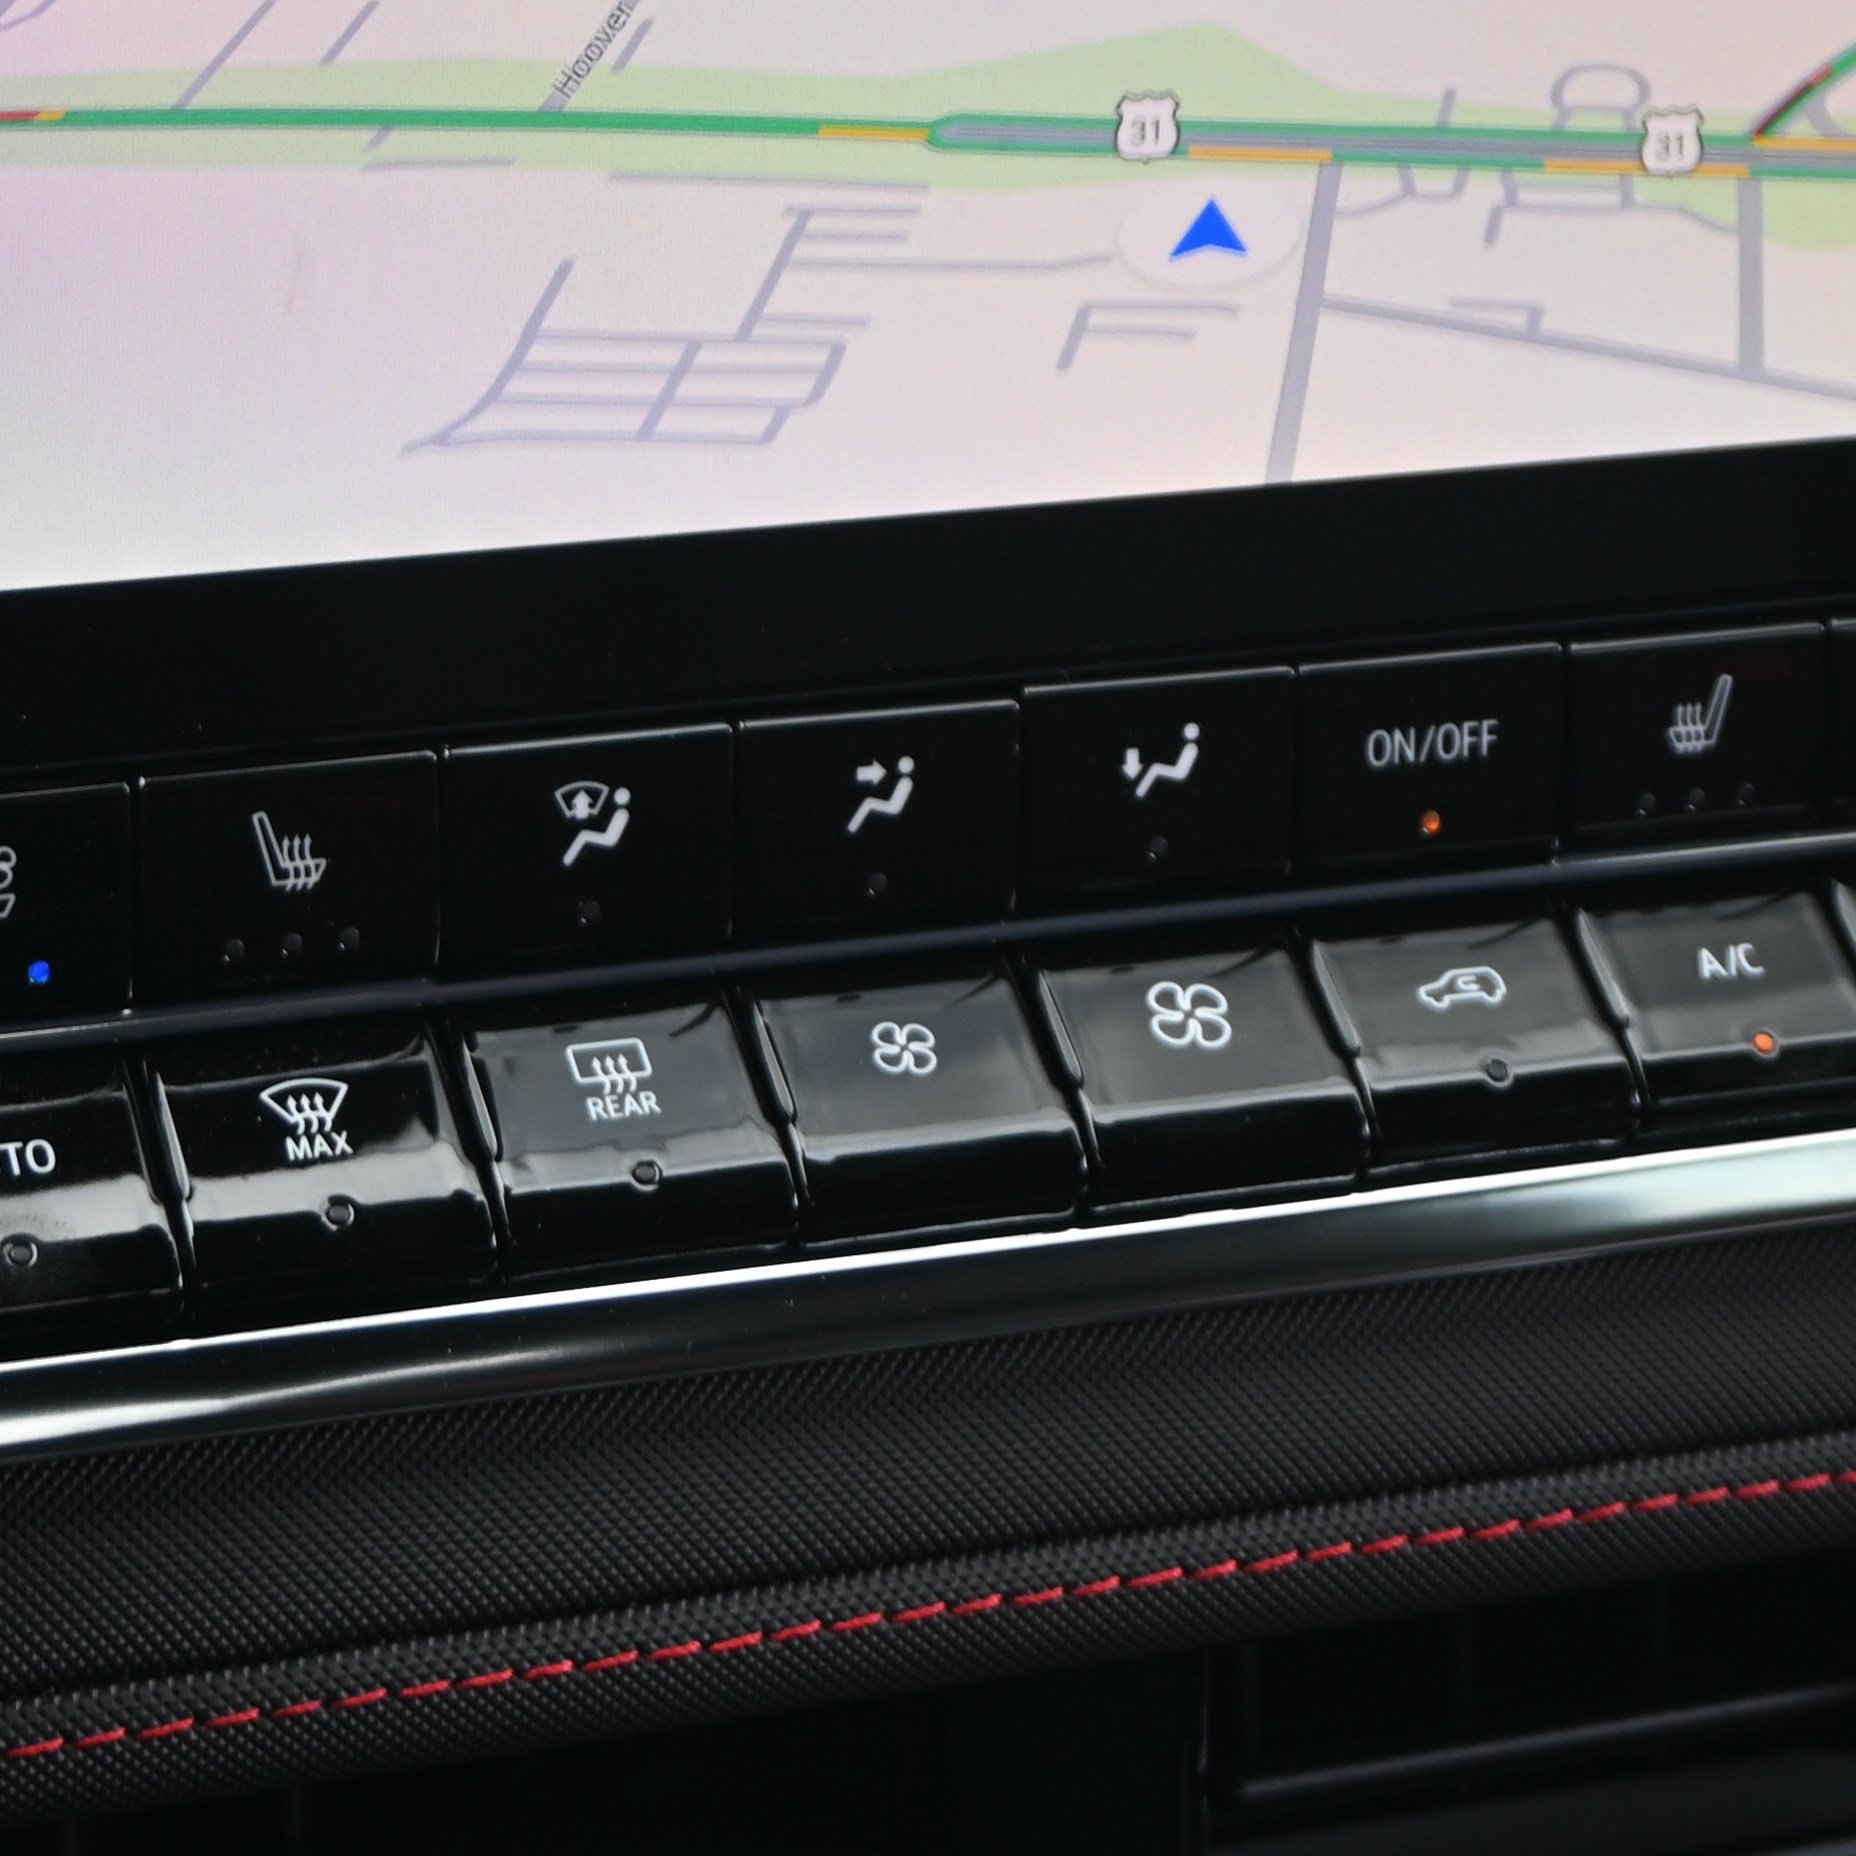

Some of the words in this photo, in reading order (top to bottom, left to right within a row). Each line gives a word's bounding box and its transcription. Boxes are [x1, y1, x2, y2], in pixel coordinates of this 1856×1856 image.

[1130, 115, 1161, 146] 31
[1655, 130, 1684, 162] 31
[1365, 718, 1499, 769] ON/OFF
[1697, 942, 1765, 982] A/C
[586, 1090, 662, 1123] REAR
[285, 1131, 353, 1162] MAX
